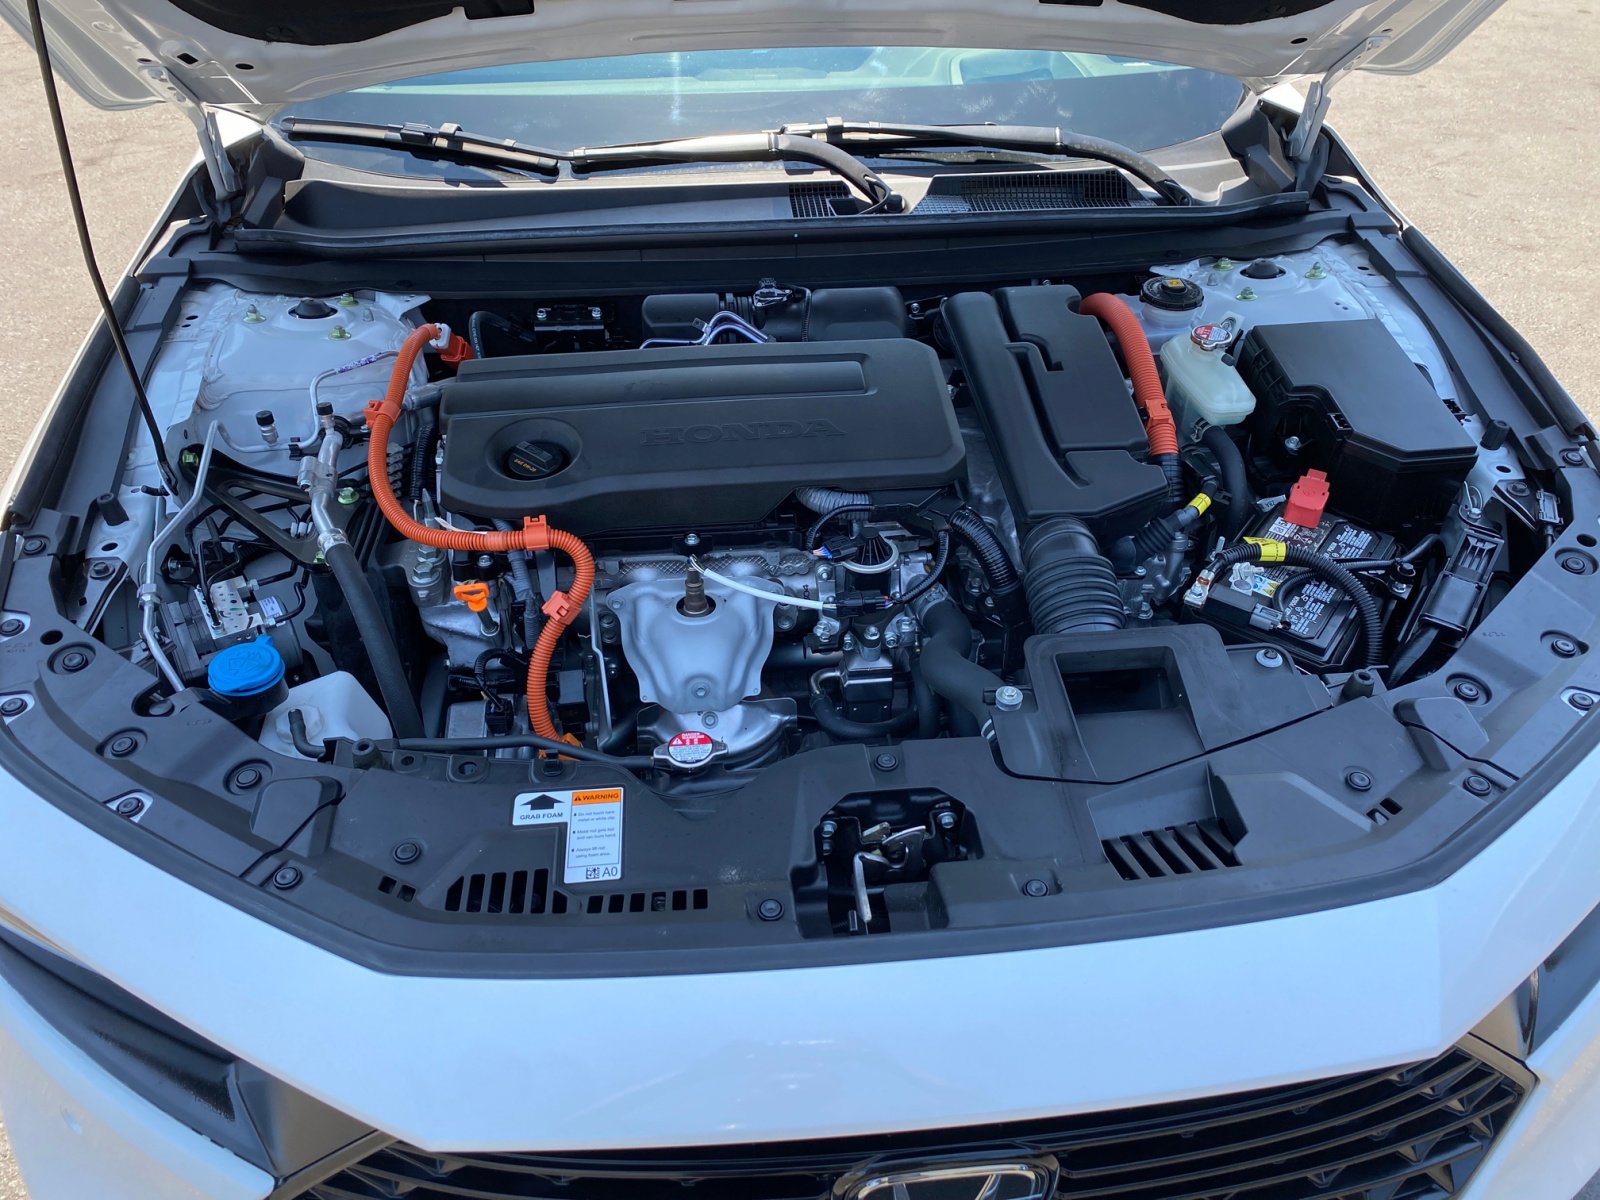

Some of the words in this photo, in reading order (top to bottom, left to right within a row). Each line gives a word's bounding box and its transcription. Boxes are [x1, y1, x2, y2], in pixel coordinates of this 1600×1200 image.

[640, 418, 847, 446] HONDA
[582, 793, 619, 801] WARNING
[520, 812, 541, 820] GRAB
[602, 866, 618, 878] A0
